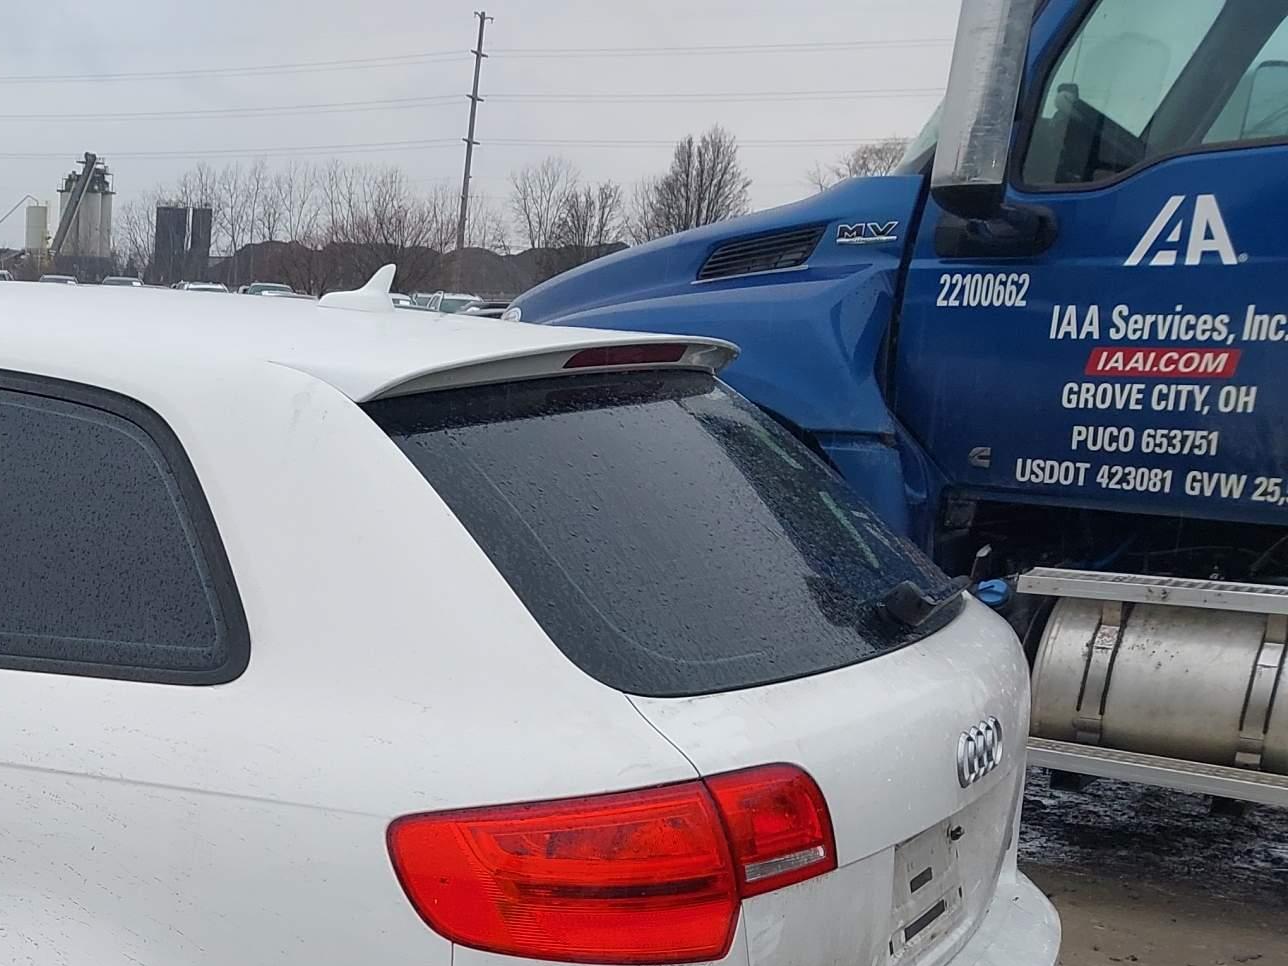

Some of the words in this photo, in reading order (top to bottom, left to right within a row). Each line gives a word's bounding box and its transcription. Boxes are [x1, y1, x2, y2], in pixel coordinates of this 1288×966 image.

[836, 221, 899, 241] MV
[936, 273, 1030, 307] 22100662
[1049, 304, 1100, 340] IAA
[1109, 304, 1235, 345] Services,
[1241, 304, 1288, 342] Inc.
[1096, 351, 1229, 373] IAAI.COM
[1061, 382, 1146, 410] GROVE
[1151, 383, 1211, 415] CITY,
[1218, 385, 1258, 413] OH
[1071, 425, 1135, 452] PUCO
[1141, 428, 1219, 456] 653751
[1015, 457, 1091, 486] USDOT
[1095, 464, 1173, 493] 423081
[1185, 470, 1248, 499] GVW
[1251, 476, 1288, 506] 25,
